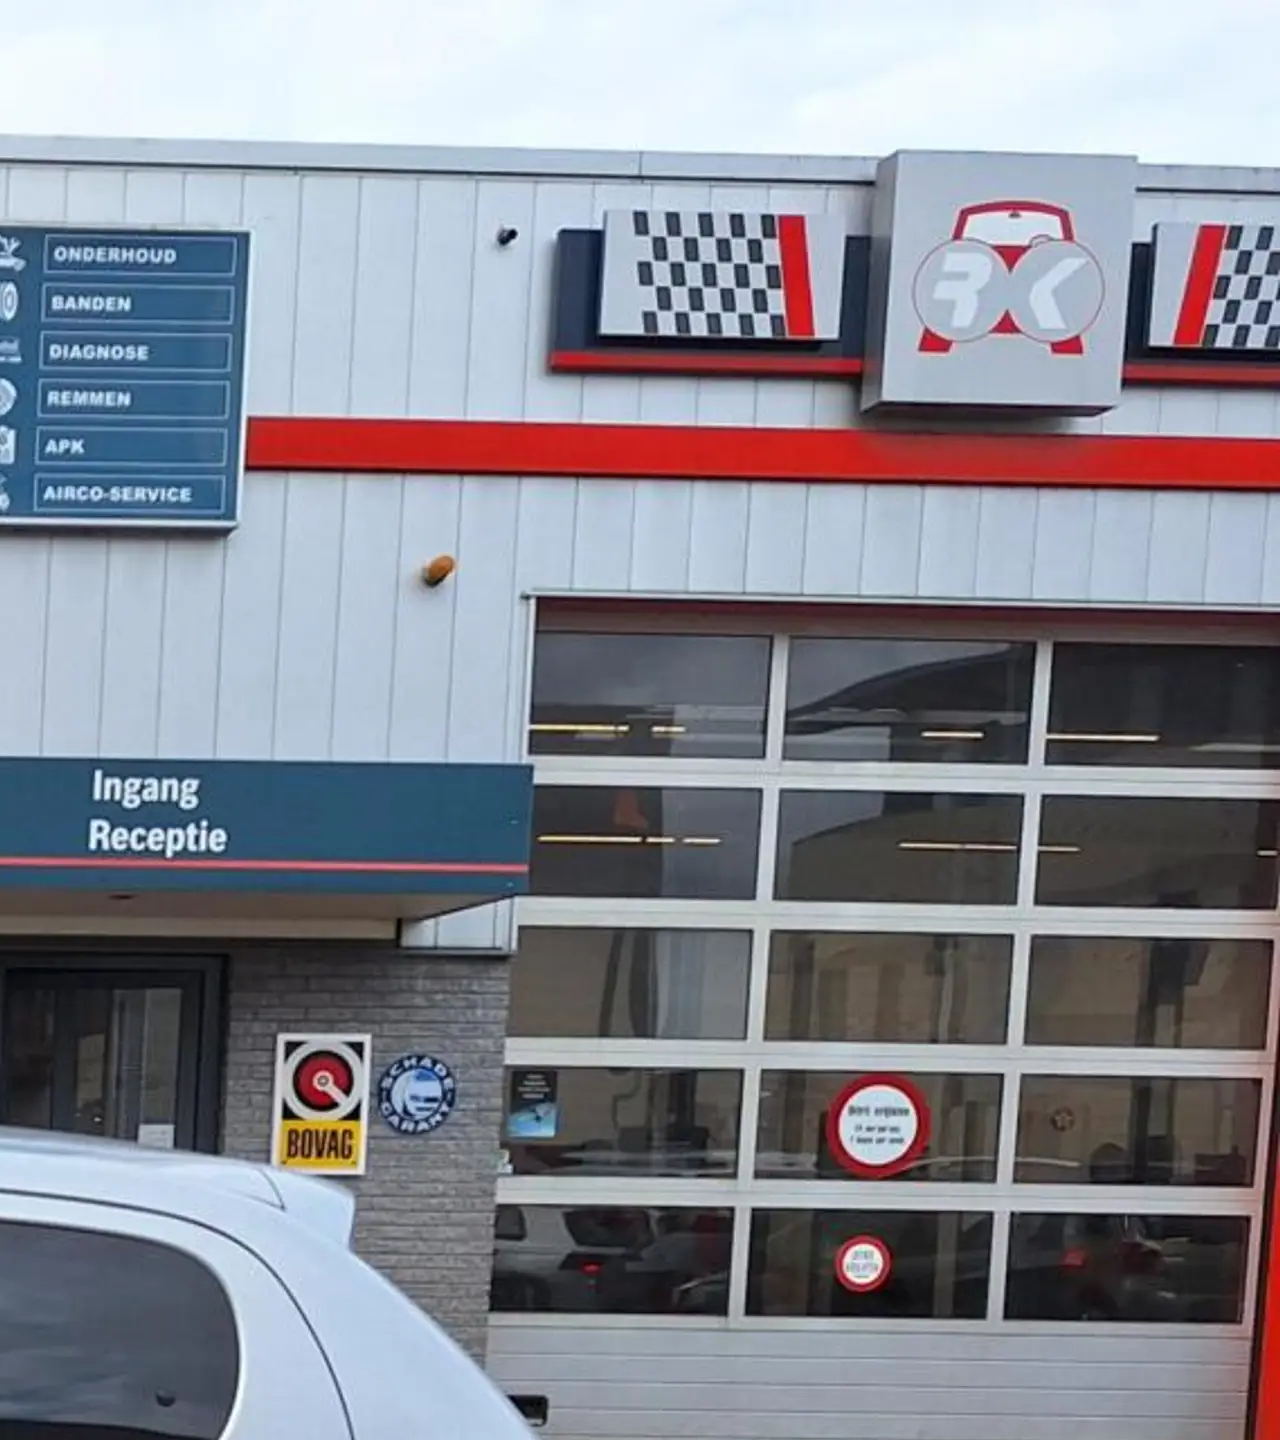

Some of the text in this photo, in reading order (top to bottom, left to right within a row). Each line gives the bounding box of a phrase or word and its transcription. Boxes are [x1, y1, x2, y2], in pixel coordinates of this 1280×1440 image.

[53, 245, 177, 264] ONDERHOUD
[51, 295, 132, 312] BANDEN
[49, 344, 150, 361] DIAGNOSE
[47, 390, 132, 408] REMMEN
[44, 438, 85, 454] APK
[43, 485, 193, 503] AIRCO-SERVICE
[92, 768, 201, 810] Ingang
[88, 818, 228, 858] Receptie
[380, 1055, 455, 1088] SCHADE
[380, 1102, 450, 1132] GARANT
[286, 1127, 354, 1160] BOVAG
